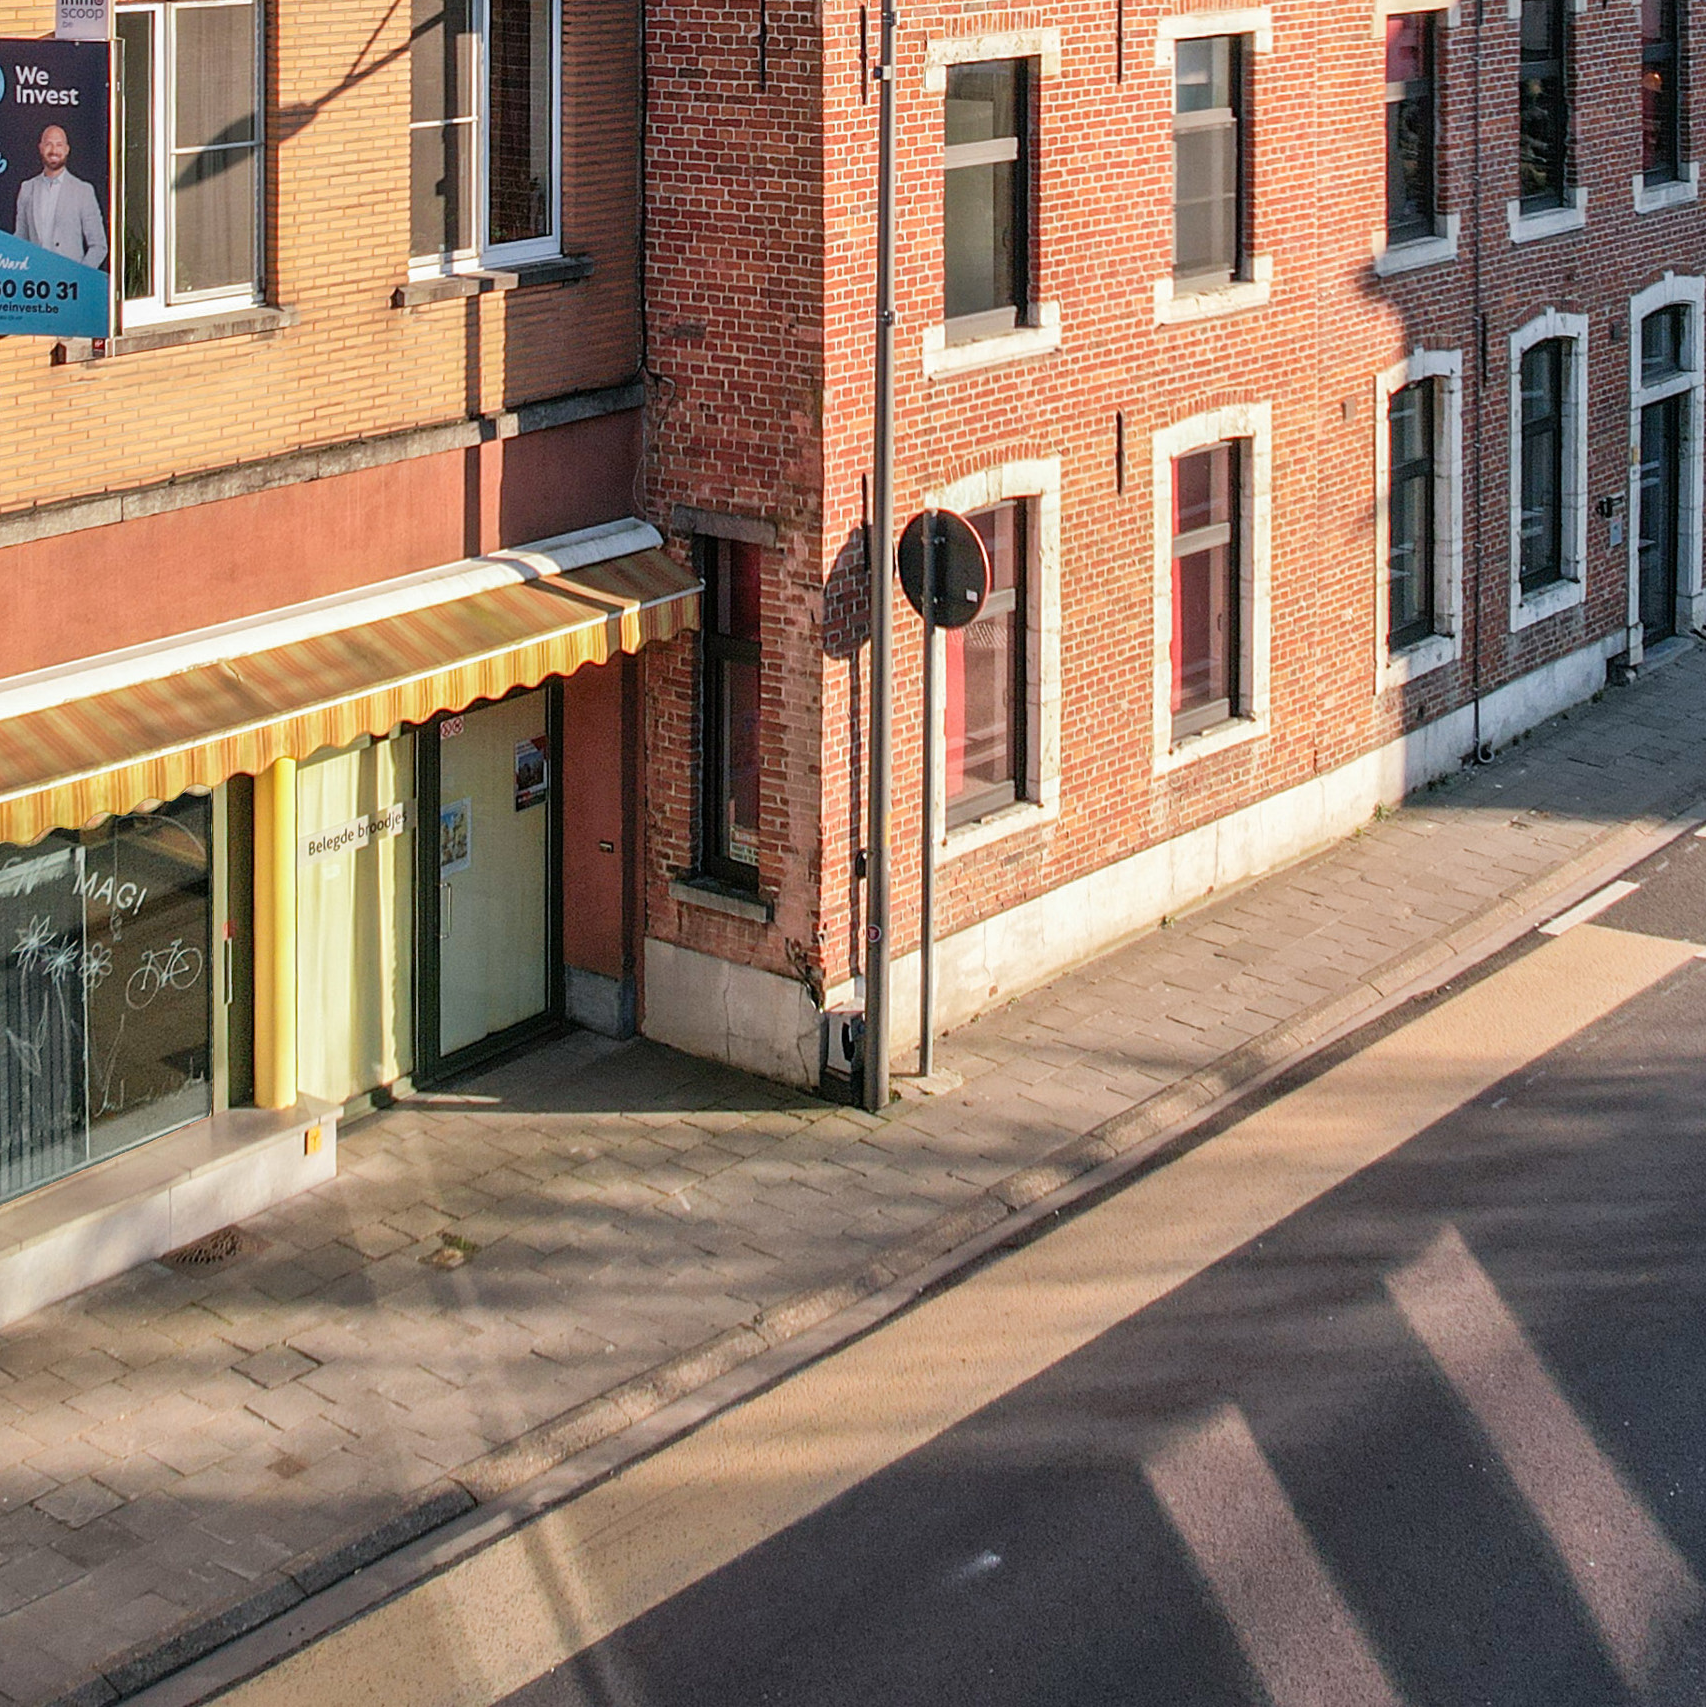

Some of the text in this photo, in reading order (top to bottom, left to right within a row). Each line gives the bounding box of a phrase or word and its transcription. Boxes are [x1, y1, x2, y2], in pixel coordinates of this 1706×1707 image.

[61, 8, 104, 21] scoop
[15, 65, 49, 85] We
[15, 85, 79, 105] Invest
[23, 280, 51, 299] 60
[56, 281, 79, 301] 31
[308, 811, 408, 856] Belegde broodjes
